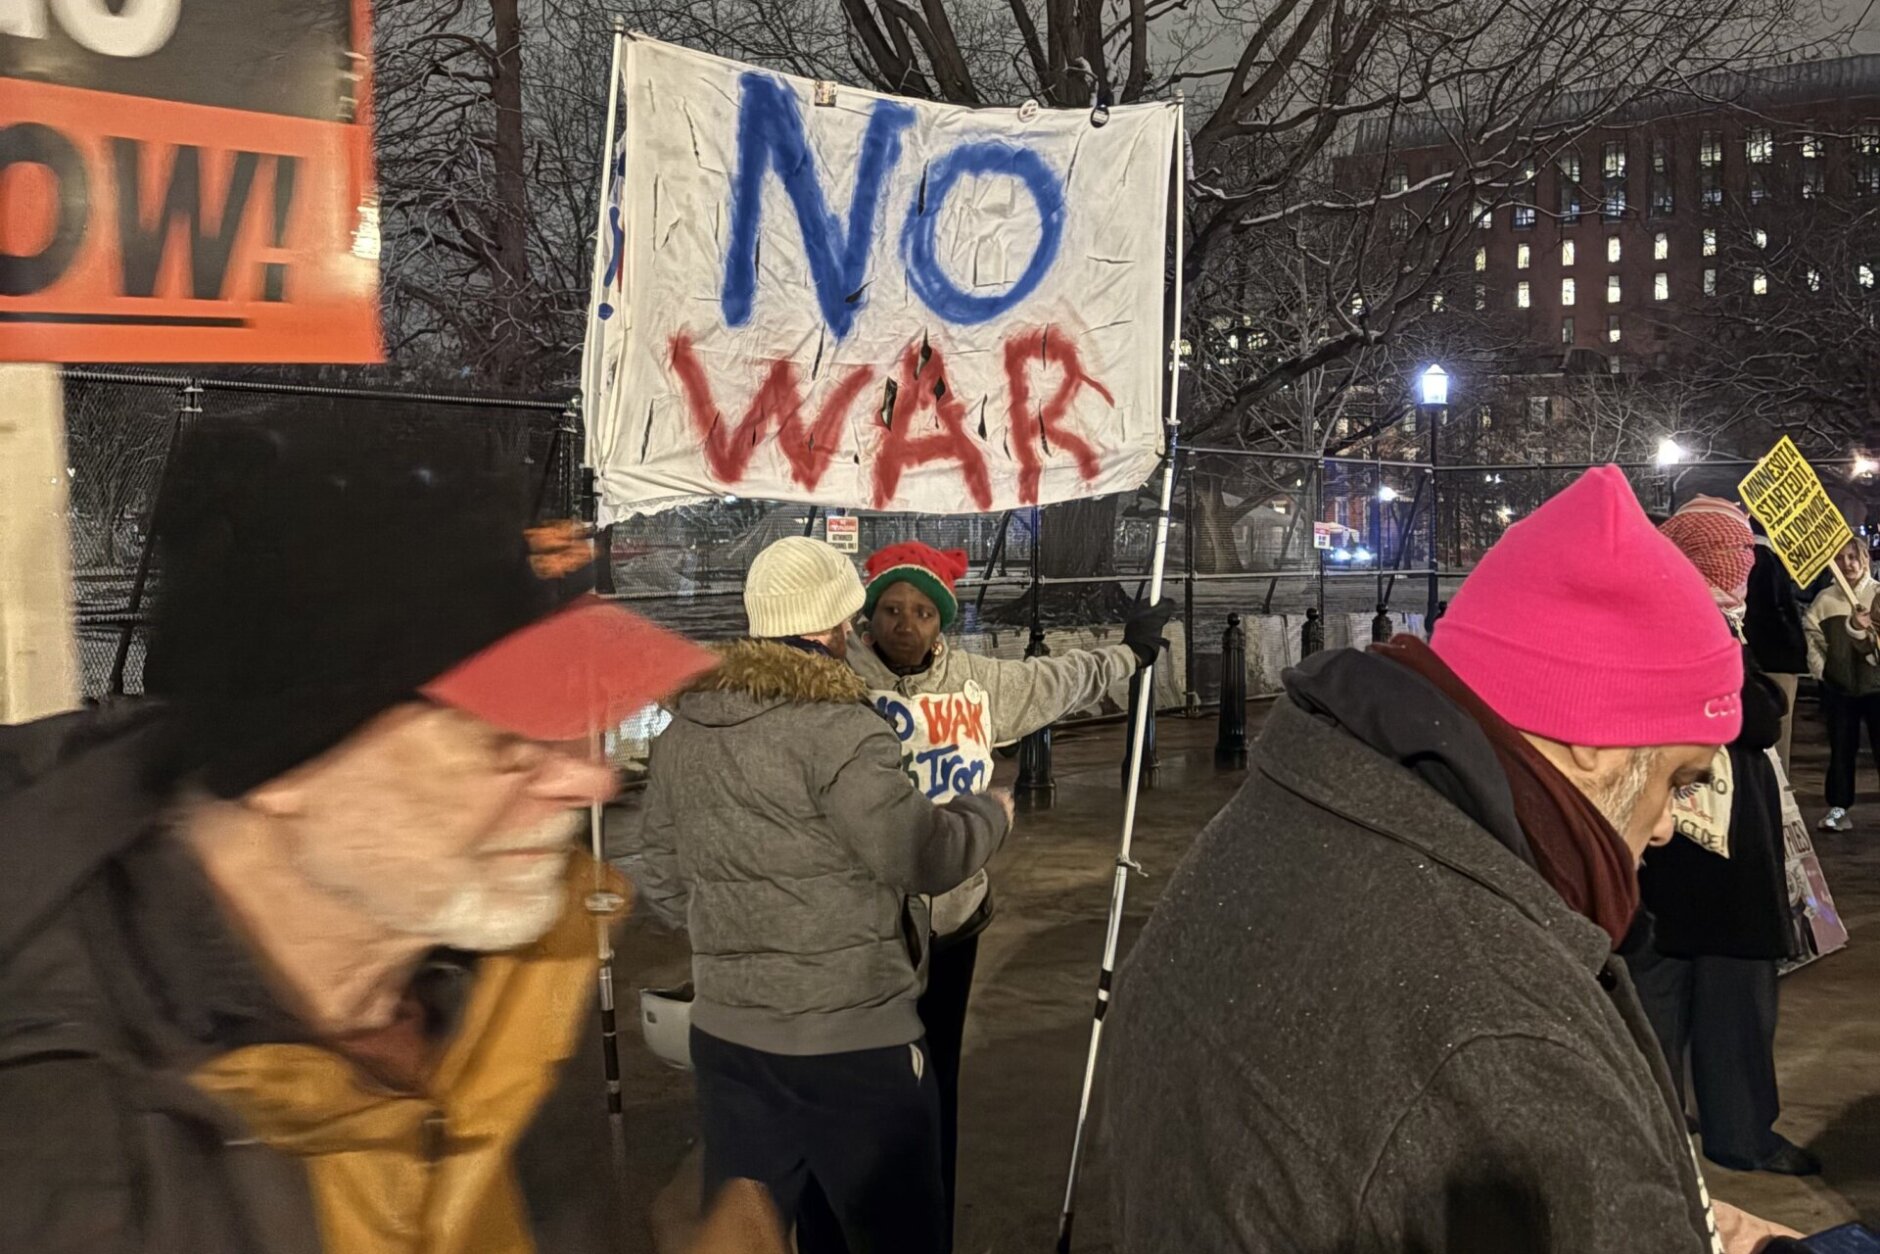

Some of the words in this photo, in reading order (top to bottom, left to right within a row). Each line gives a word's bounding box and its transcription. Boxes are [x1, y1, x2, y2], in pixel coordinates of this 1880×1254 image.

[719, 70, 1066, 342] NO
[667, 324, 1116, 511] WAR
[1742, 441, 1799, 505] MINNESOTA
[1756, 470, 1804, 524] STARTED
[1769, 506, 1793, 532] TIME
[1793, 487, 1812, 510] FOR
[1773, 489, 1830, 556] NATIONWIDE
[1787, 508, 1842, 571] SHUTDOWN!
[877, 696, 915, 741] O
